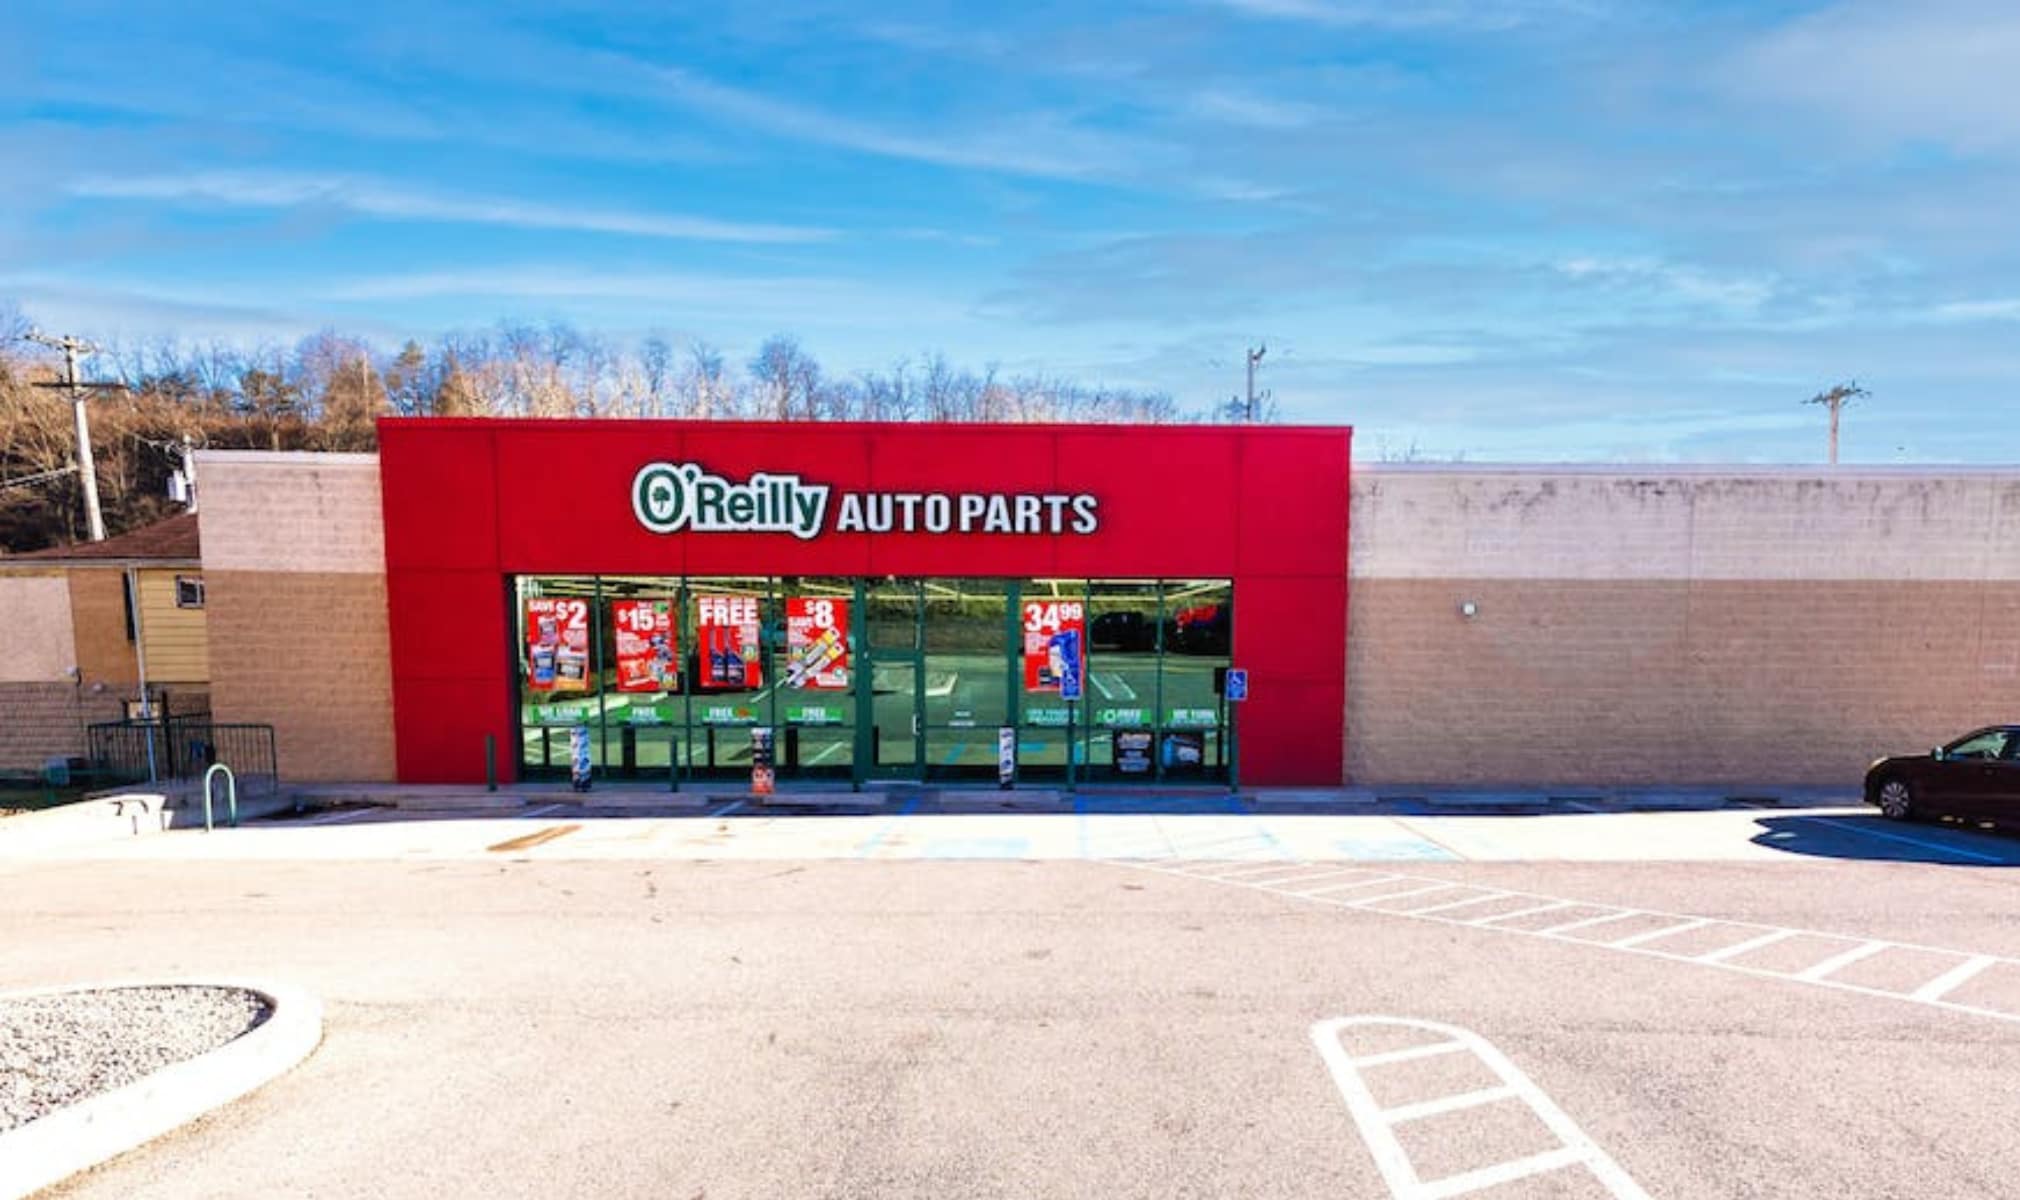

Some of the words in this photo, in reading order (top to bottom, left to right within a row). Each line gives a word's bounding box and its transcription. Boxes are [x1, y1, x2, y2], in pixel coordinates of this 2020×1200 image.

[633, 463, 828, 538] O'Reilly
[837, 494, 951, 533] AUTO
[960, 494, 1098, 533] PARTS
[555, 601, 587, 629] $2
[617, 608, 654, 631] $15
[699, 600, 758, 626] FREE
[805, 600, 834, 628] $8
